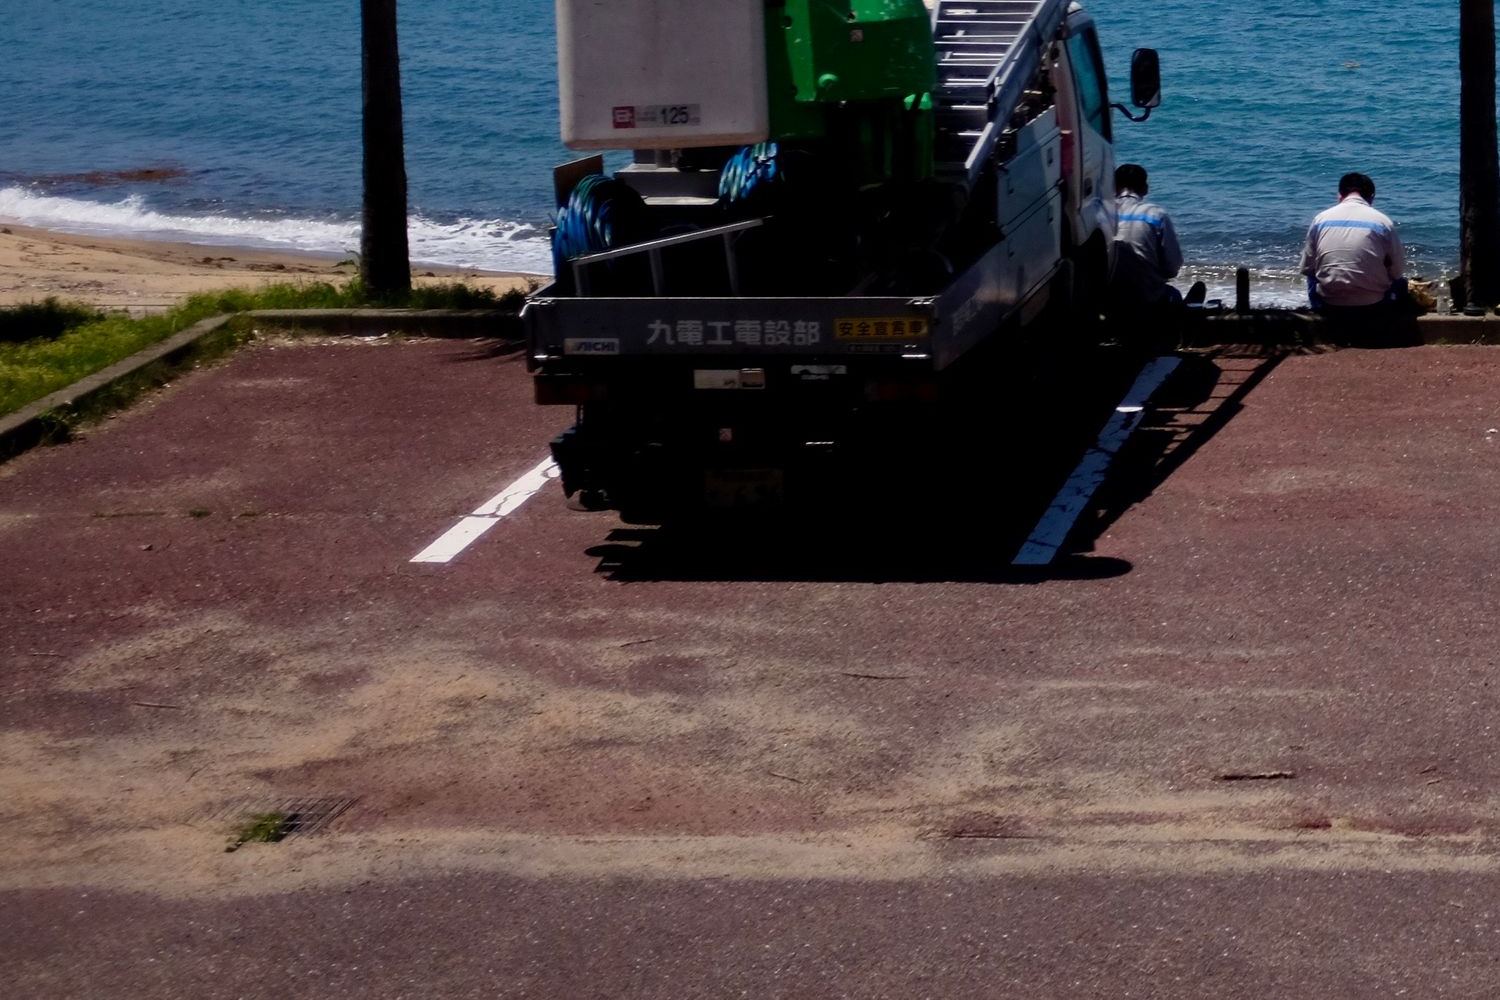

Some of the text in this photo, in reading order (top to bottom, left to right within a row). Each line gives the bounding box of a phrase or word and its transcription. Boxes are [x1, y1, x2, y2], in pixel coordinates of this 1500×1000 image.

[660, 106, 689, 125] 125
[646, 319, 820, 346] 九電工電設部
